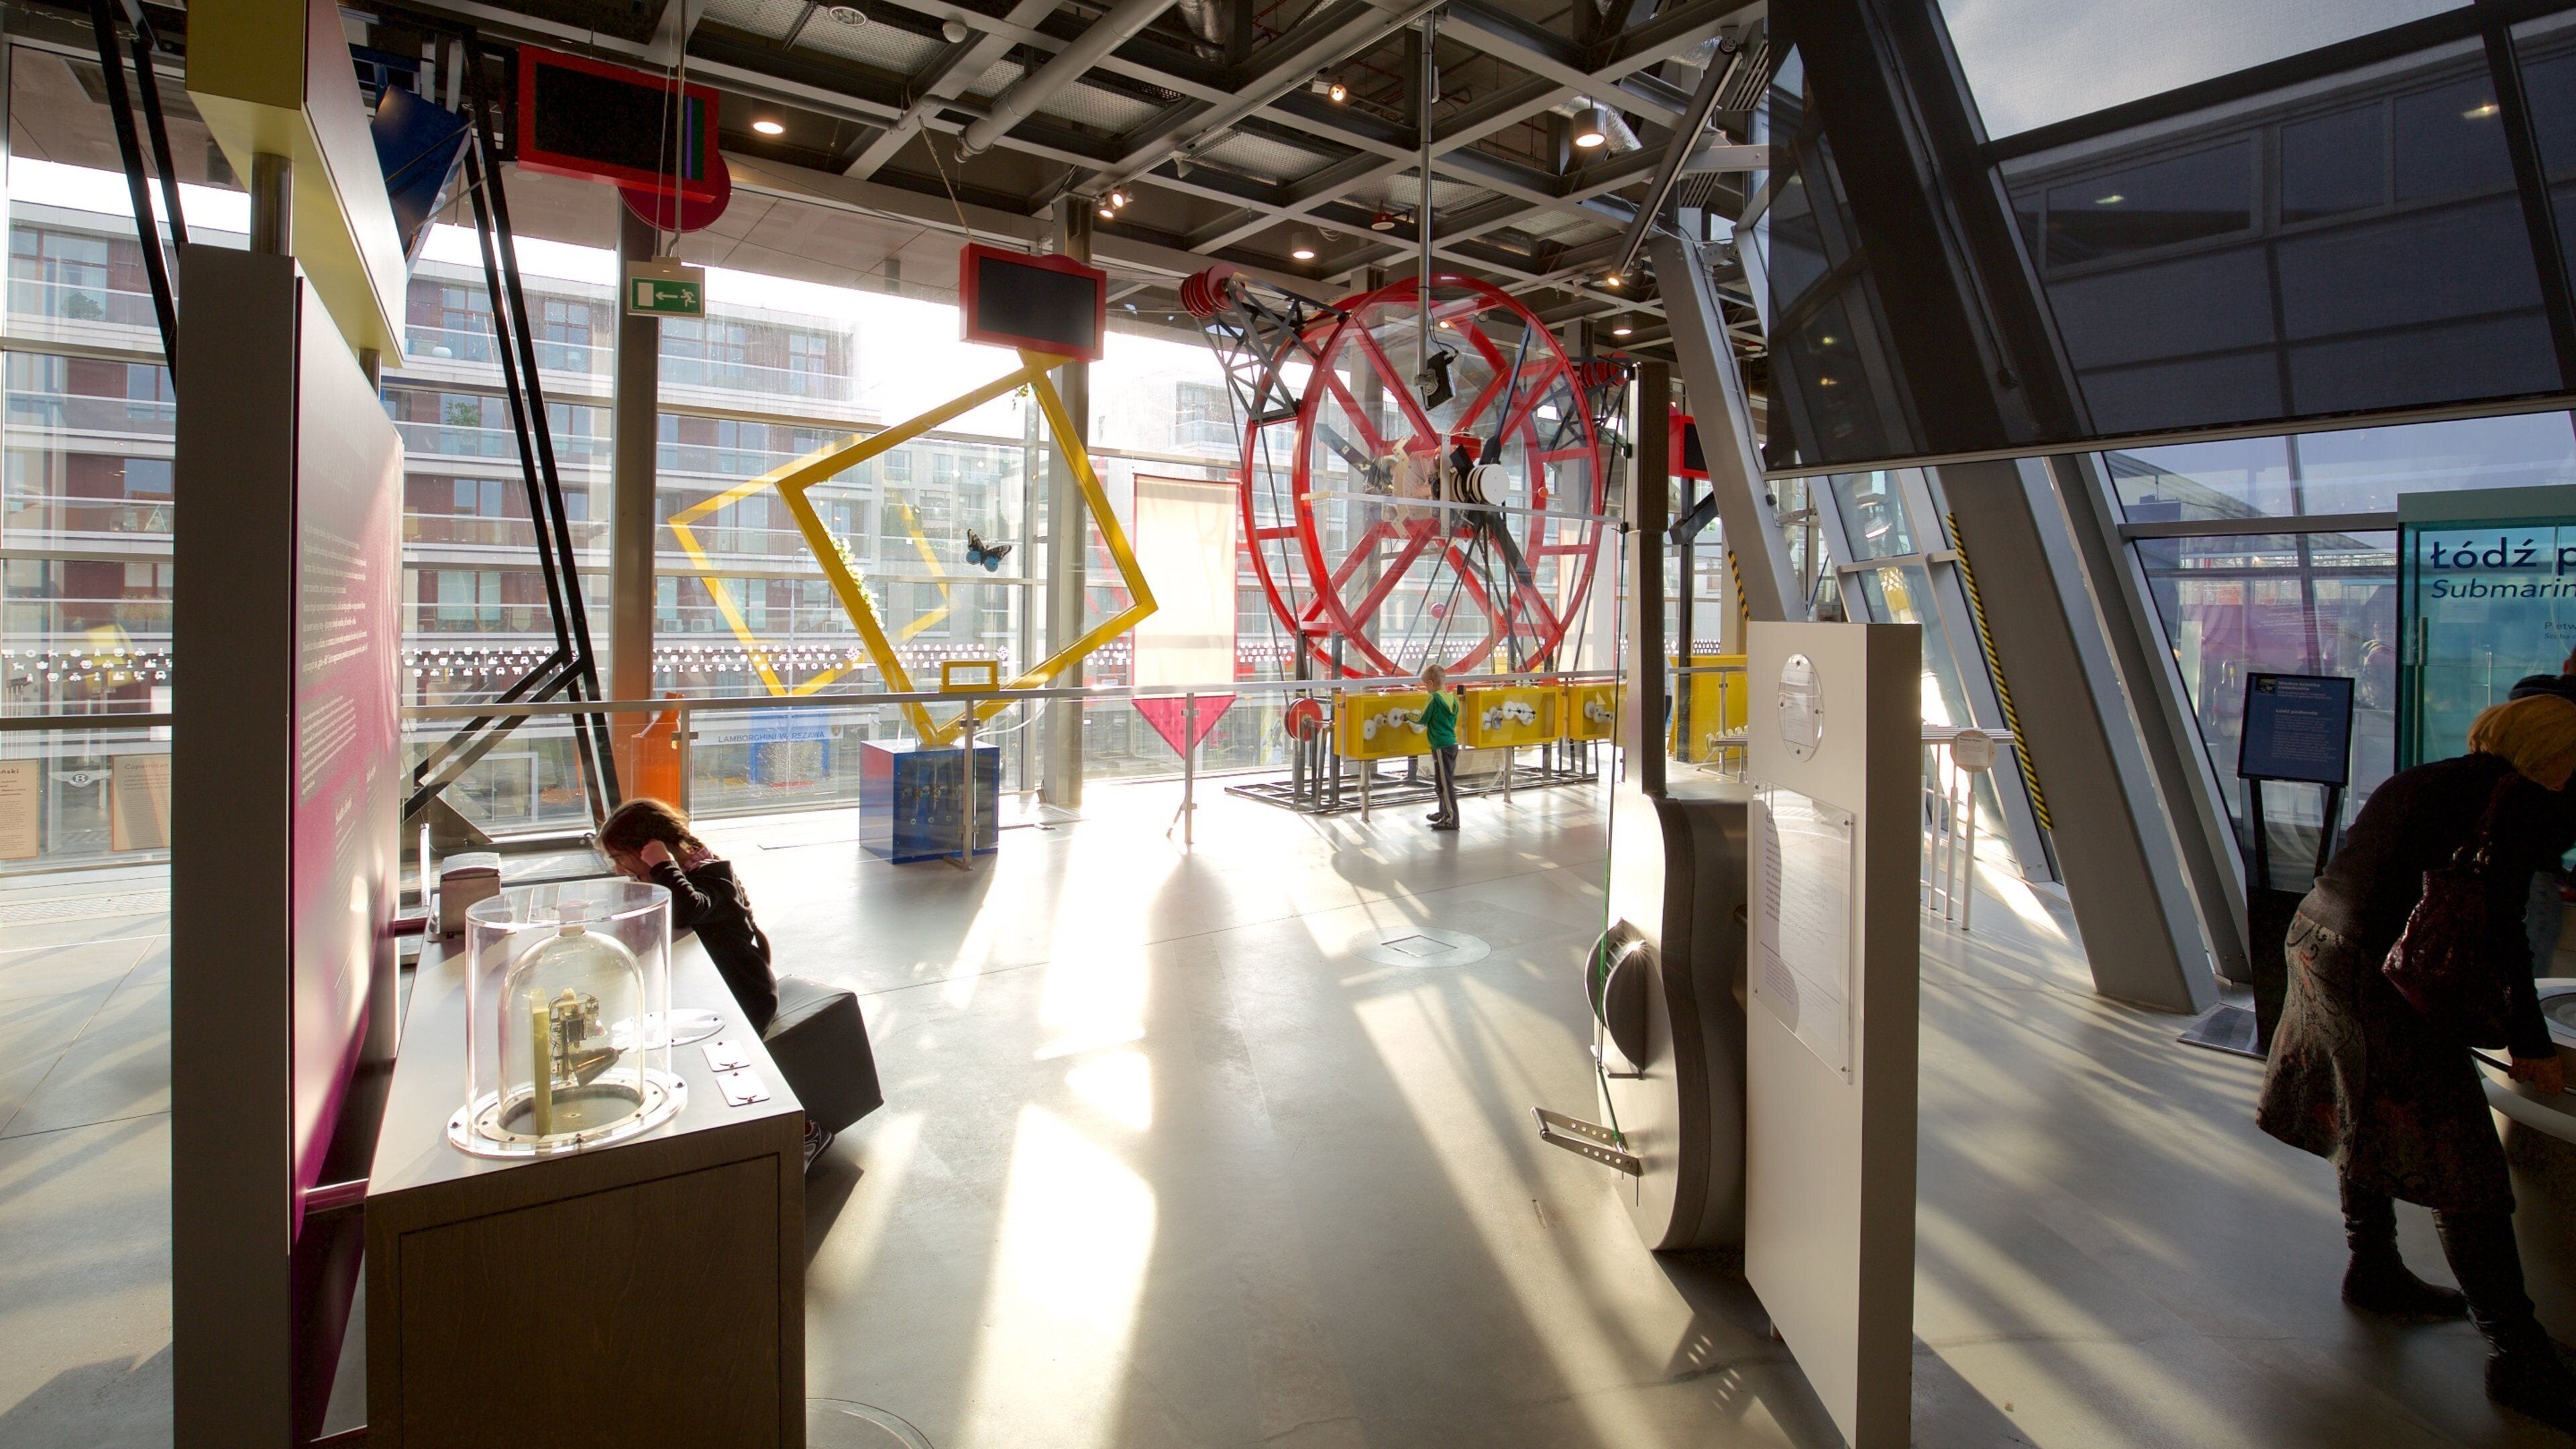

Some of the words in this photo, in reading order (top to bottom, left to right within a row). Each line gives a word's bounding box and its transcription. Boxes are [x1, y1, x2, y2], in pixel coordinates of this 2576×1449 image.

[2430, 537, 2537, 569] Łódź
[2431, 578, 2576, 598] Submarin
[2544, 622, 2576, 630] Petw
[718, 733, 777, 743] LAMBORGHINI
